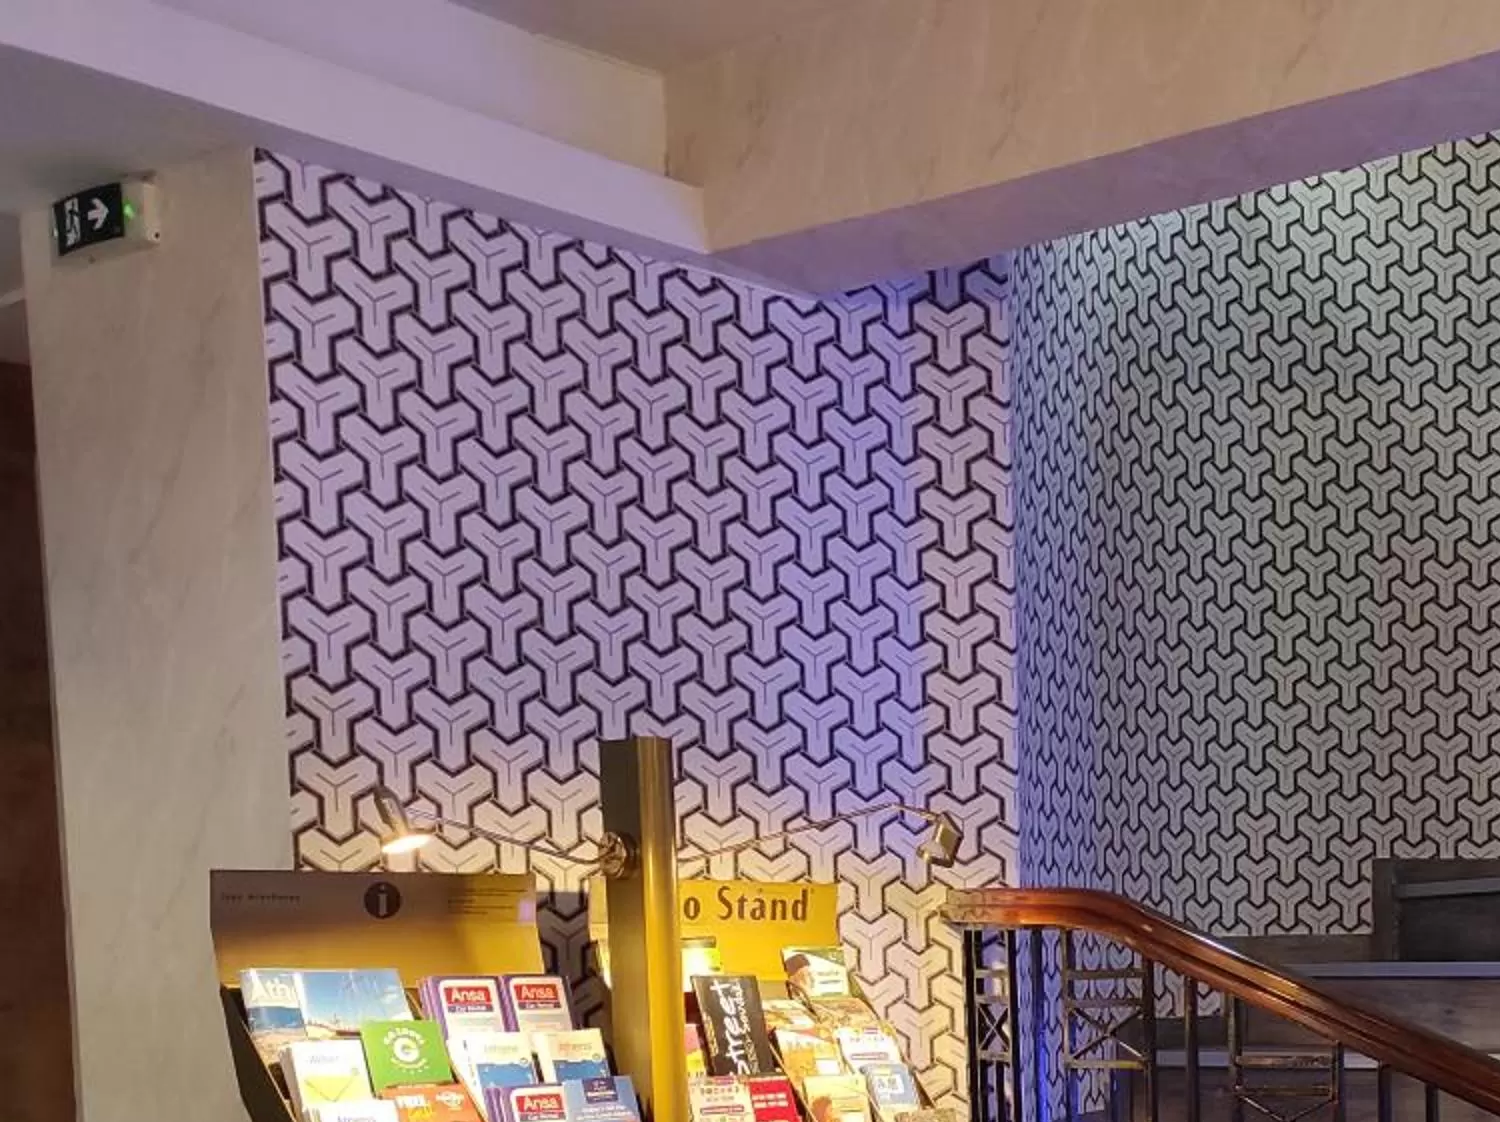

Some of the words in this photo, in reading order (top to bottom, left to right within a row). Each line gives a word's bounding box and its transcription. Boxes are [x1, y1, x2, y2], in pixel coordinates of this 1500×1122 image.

[717, 885, 808, 922] Stand
[451, 987, 488, 1003] Ansa
[520, 984, 557, 1001] Ansa
[523, 1094, 559, 1110] Ansa
